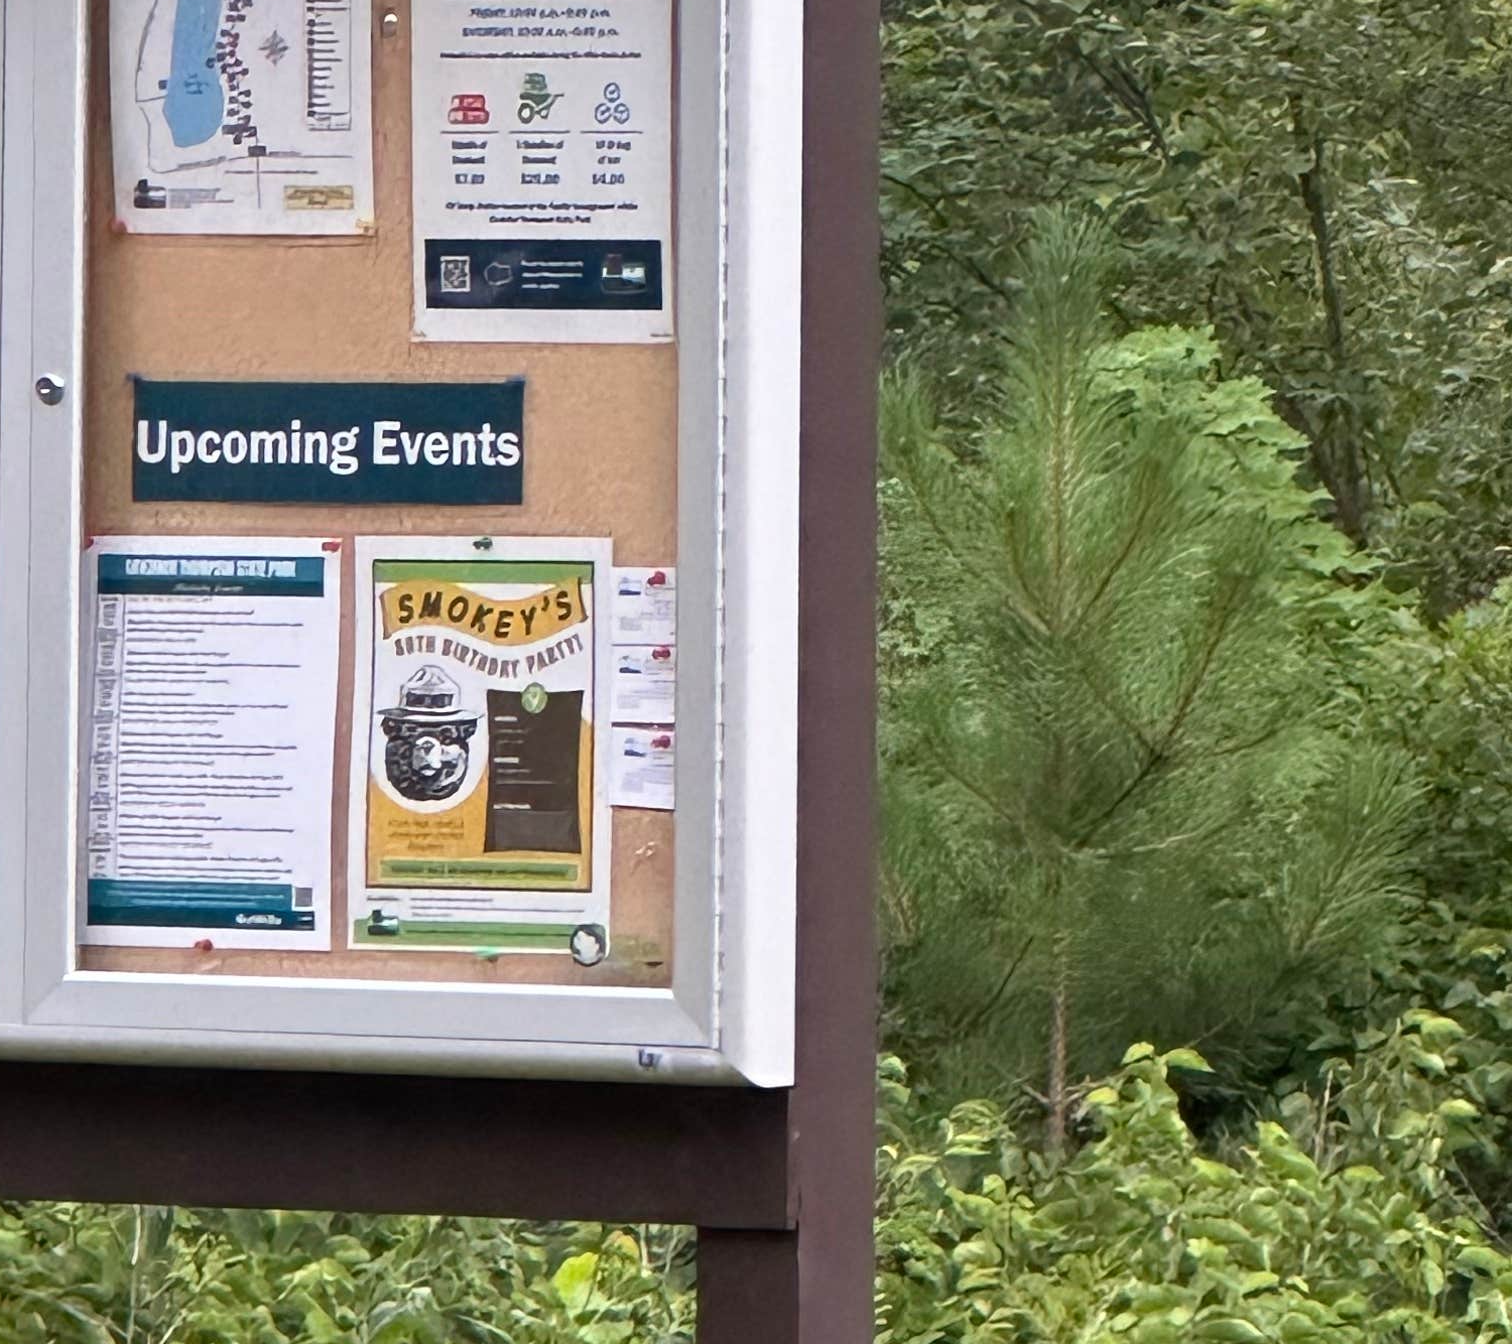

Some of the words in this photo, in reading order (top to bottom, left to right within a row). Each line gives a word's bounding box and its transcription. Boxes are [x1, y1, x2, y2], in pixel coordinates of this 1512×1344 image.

[137, 419, 360, 476] Upcoming
[372, 420, 521, 467] Events
[398, 590, 572, 638] SMOKEY'S
[441, 638, 521, 679] BIRTHDAY
